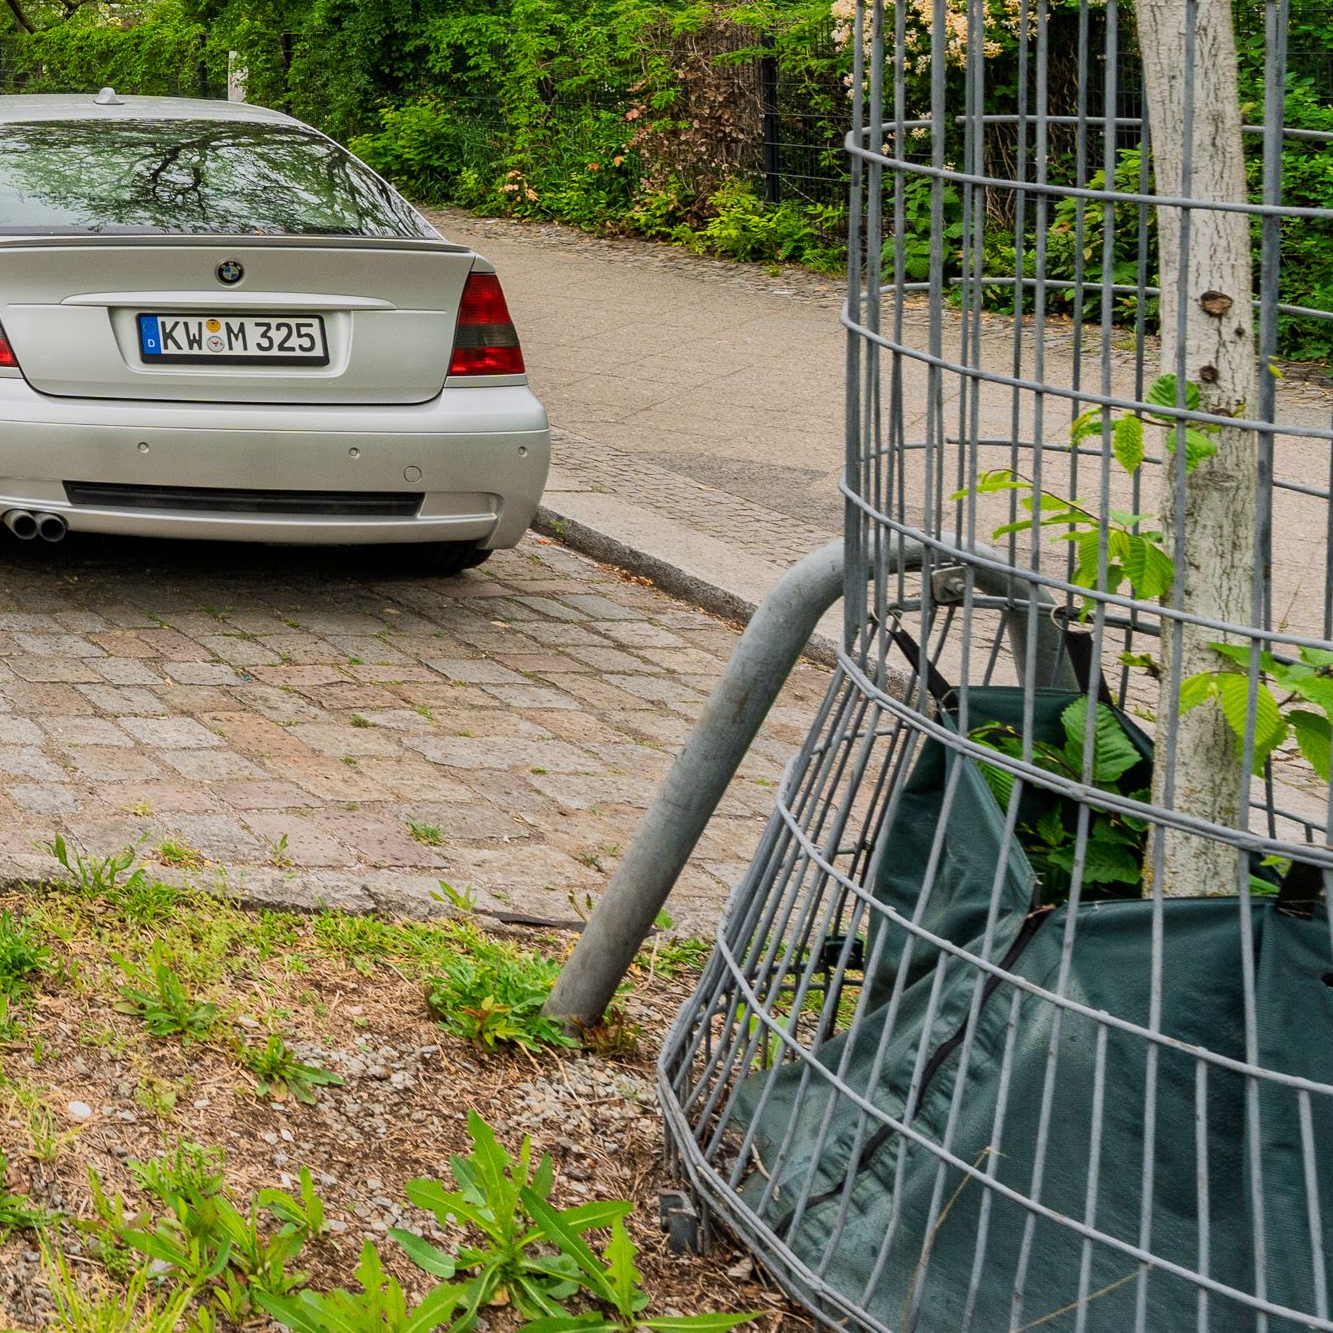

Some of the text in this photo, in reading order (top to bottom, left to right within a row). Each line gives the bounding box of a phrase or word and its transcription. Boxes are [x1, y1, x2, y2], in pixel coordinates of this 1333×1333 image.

[147, 338, 156, 348] D
[160, 320, 316, 353] KW M 325
